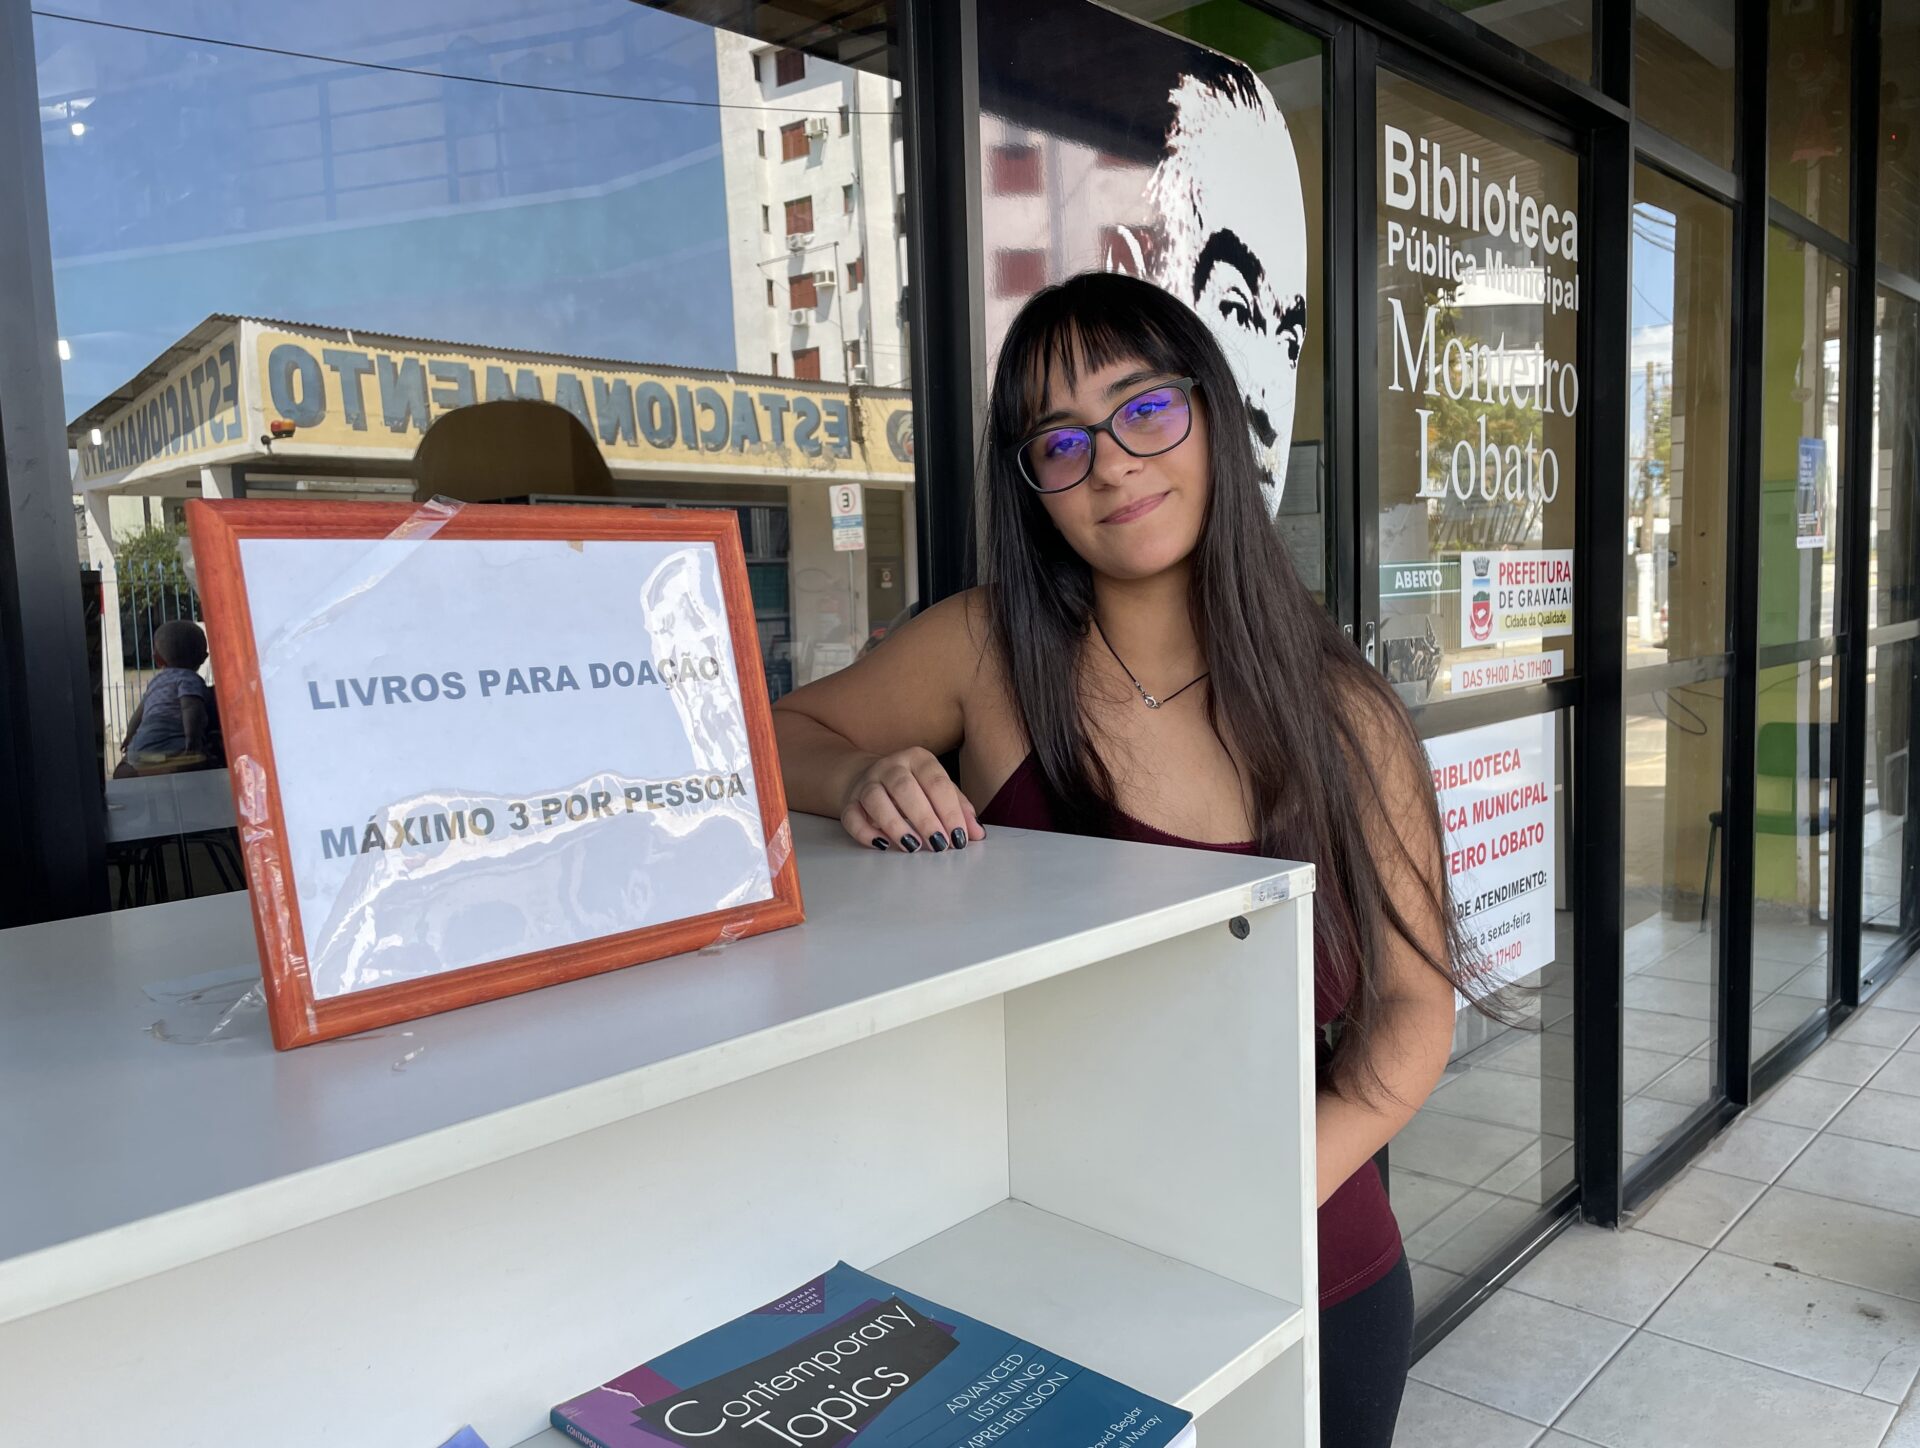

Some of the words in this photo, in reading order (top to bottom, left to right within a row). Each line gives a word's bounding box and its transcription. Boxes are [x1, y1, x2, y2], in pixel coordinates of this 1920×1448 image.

[1385, 124, 1579, 262] Biblioteca
[1387, 220, 1477, 286] Pública
[1485, 247, 1579, 315] Municipal
[1388, 297, 1579, 418] Monteiro
[1415, 408, 1559, 503] Lobato
[1395, 569, 1443, 589] ABERTO
[1499, 560, 1572, 586] PREFEITURA
[1499, 590, 1514, 609] DE
[1505, 614, 1527, 629] Cidade
[1529, 612, 1536, 626] da
[1537, 609, 1567, 626] Qualidade
[308, 671, 467, 710] LIVROS
[478, 665, 580, 697] PARA
[589, 652, 721, 691] DOAÇÃO
[1462, 668, 1483, 689] DAS
[1486, 665, 1509, 685] 9H00
[1512, 660, 1525, 681] ÀS
[1527, 659, 1552, 678] 17H00
[1432, 748, 1521, 793] BIBLIOTECA
[320, 807, 496, 860] MÁXIMO
[508, 802, 530, 832] 3
[541, 790, 615, 826] POR
[624, 772, 748, 814] PESSOA
[1472, 781, 1548, 825] MUNICIPAL
[1491, 822, 1544, 861] LOBATO
[1474, 870, 1547, 914] ATENDIMENTO:
[1487, 911, 1531, 943] sexta-feira
[1496, 940, 1522, 968] 17H00
[774, 1287, 816, 1311] LONGMAN
[786, 1293, 819, 1312] LECTURE
[664, 1304, 916, 1437] Contemporary
[946, 1354, 1024, 1415] ADVANCED
[740, 1366, 910, 1448] Topics
[968, 1363, 1046, 1423] LISTENING
[1110, 1407, 1143, 1432] Beglar
[1125, 1415, 1164, 1443] Murray
